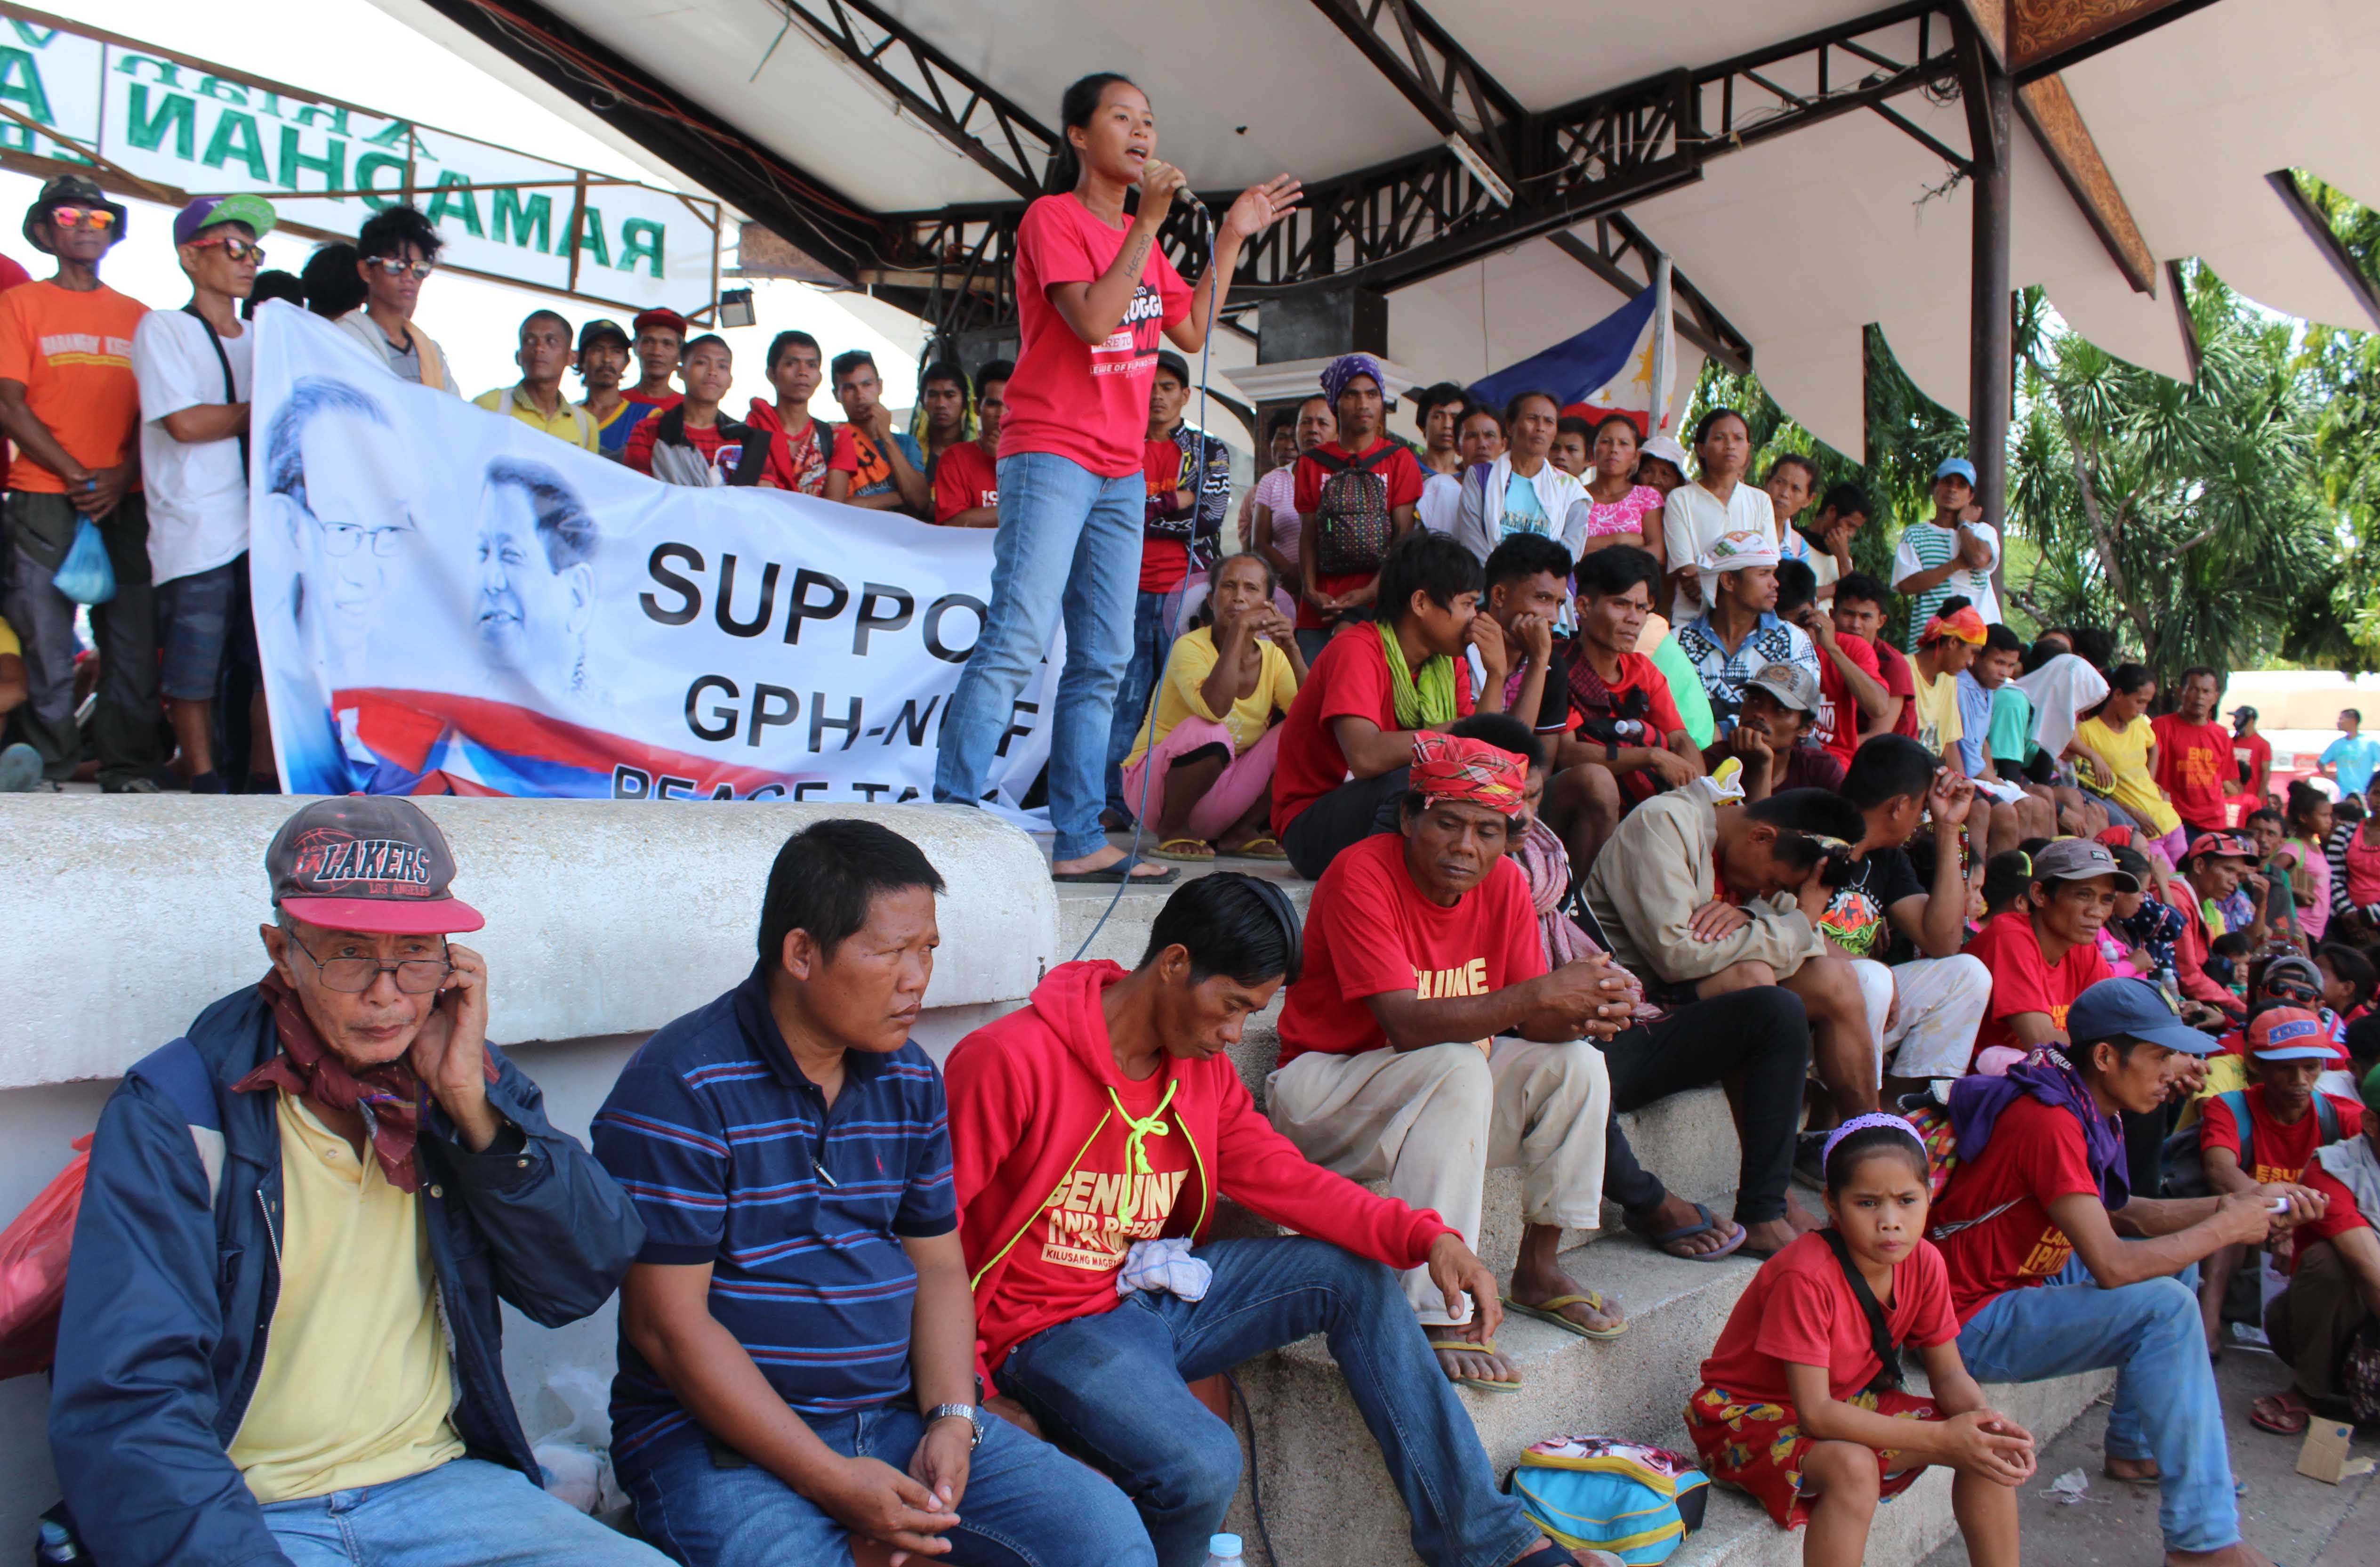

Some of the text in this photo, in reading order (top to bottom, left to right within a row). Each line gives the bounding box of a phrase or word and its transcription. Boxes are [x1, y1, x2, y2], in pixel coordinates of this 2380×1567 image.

[638, 541, 989, 664] SUPPO
[683, 674, 1039, 758] GPH-NF
[2188, 747, 2213, 762] END
[313, 839, 431, 885] LAKERS
[369, 882, 430, 897] LOS ANGELES
[1046, 1249, 1091, 1264] KILUSANG
